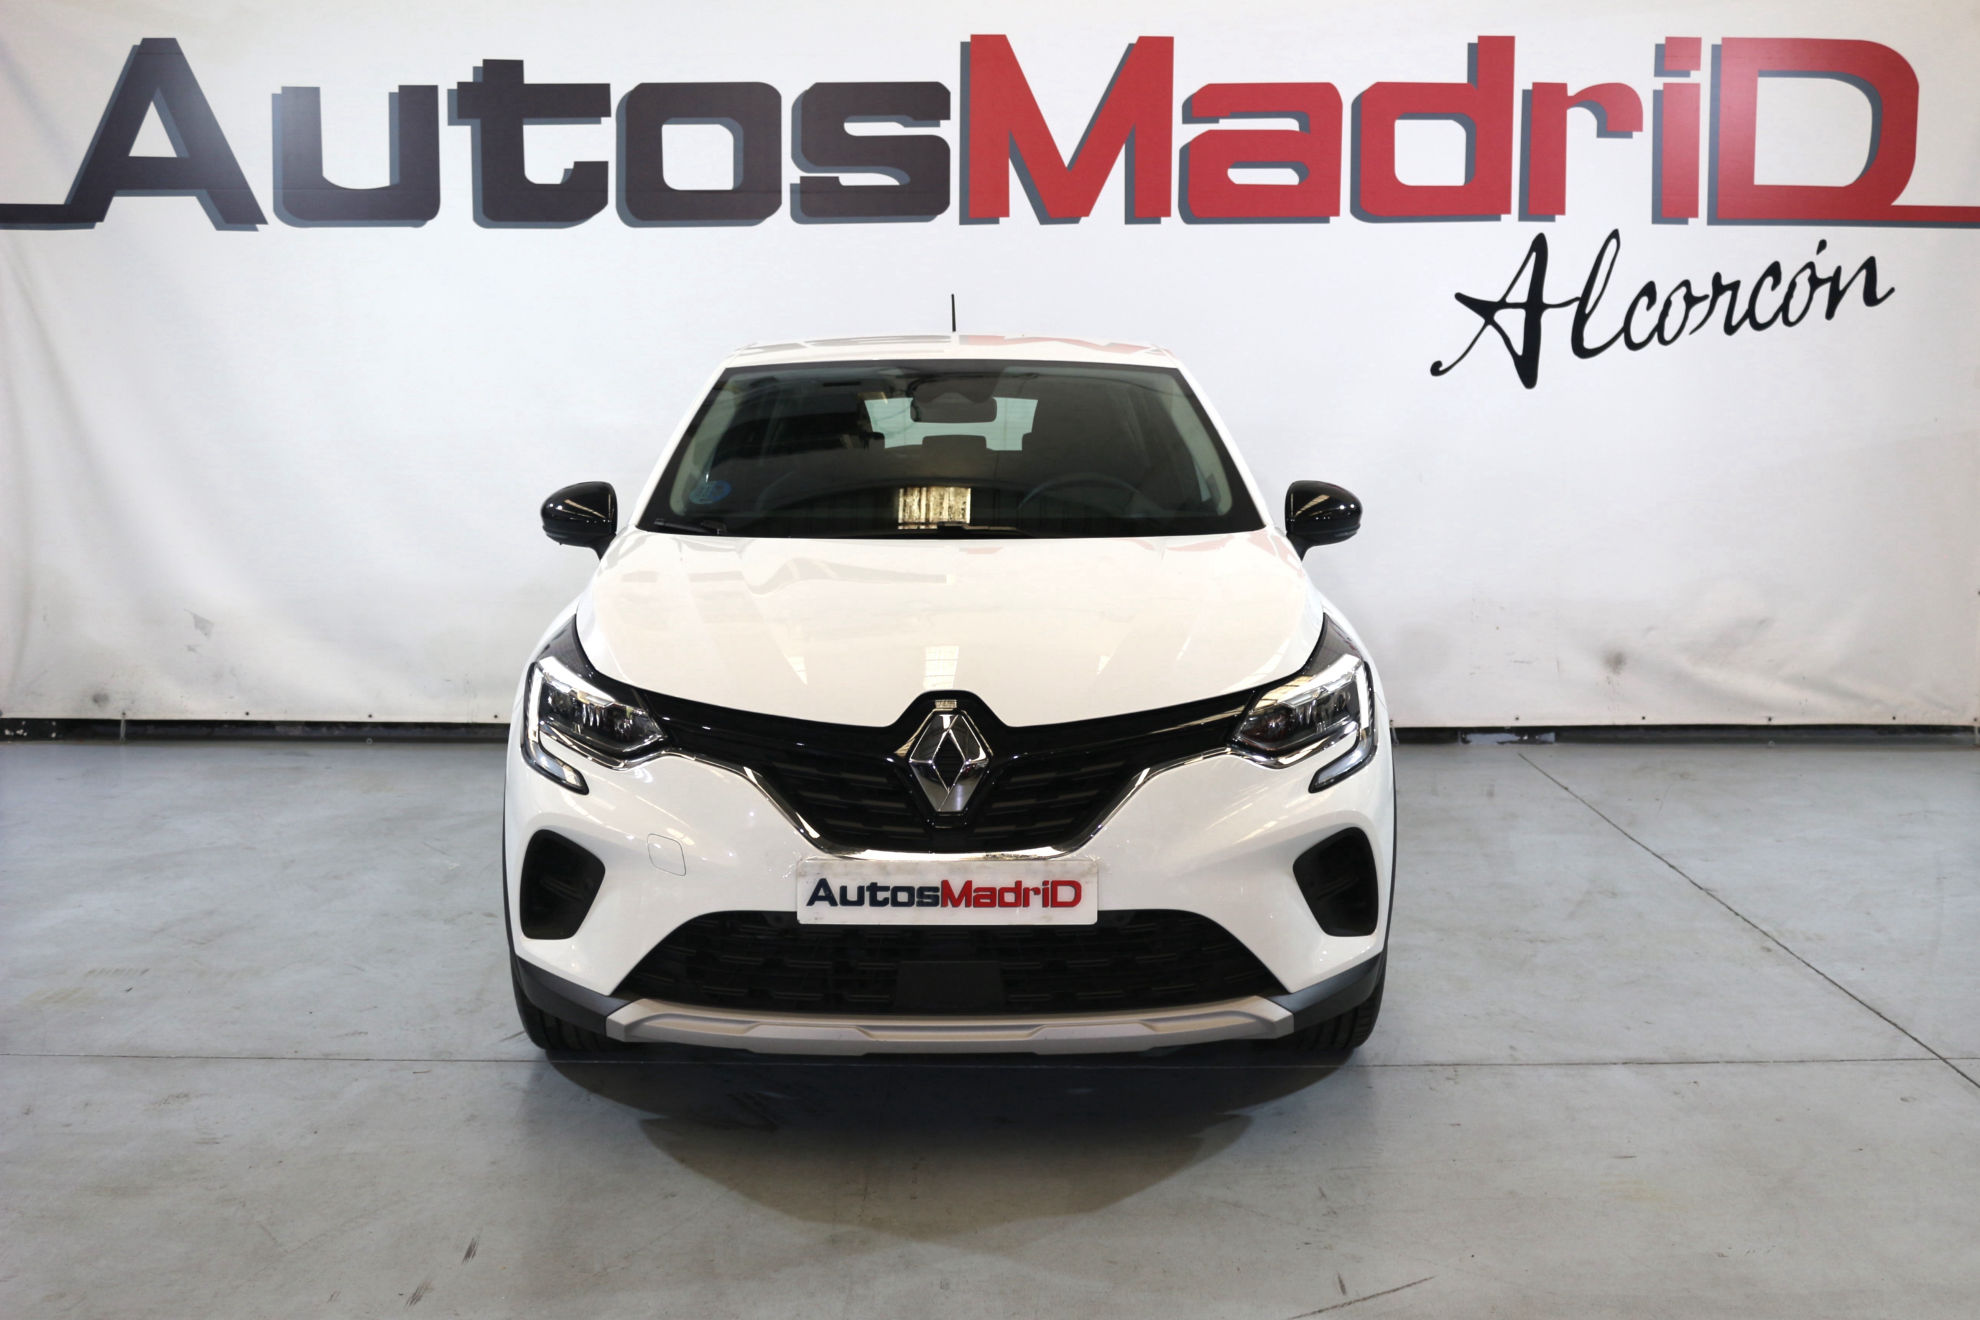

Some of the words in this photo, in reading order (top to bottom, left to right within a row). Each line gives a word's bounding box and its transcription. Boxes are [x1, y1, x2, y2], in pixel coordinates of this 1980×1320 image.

[62, 32, 1921, 232] AutosMadriD
[1429, 227, 1896, 390] Alcorcón
[806, 878, 1082, 908] AutosMadriD
